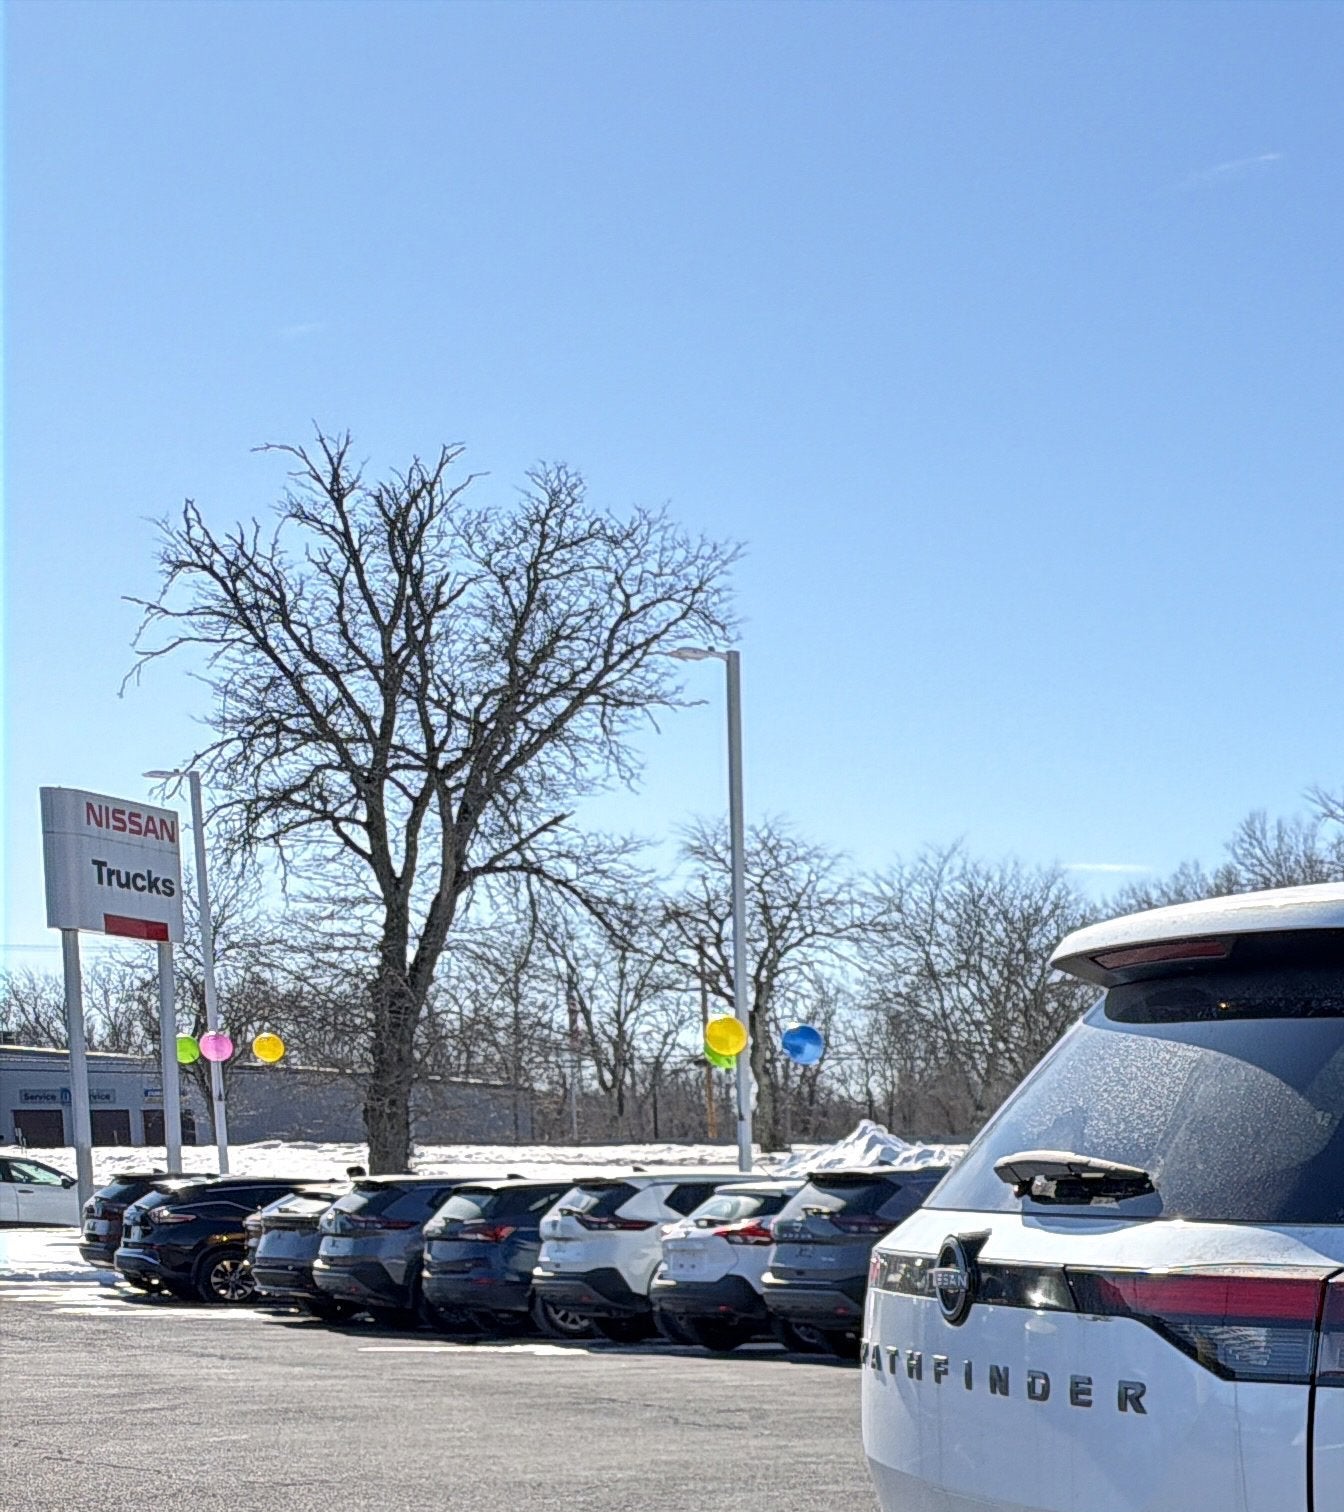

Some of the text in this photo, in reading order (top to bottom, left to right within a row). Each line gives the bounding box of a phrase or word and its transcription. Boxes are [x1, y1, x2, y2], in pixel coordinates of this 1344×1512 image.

[85, 801, 176, 843] NISSAN
[91, 859, 175, 897] Trucks
[24, 1093, 57, 1101] Service
[89, 1092, 111, 1100] rvice
[861, 1339, 1148, 1414] PATHFINDER
